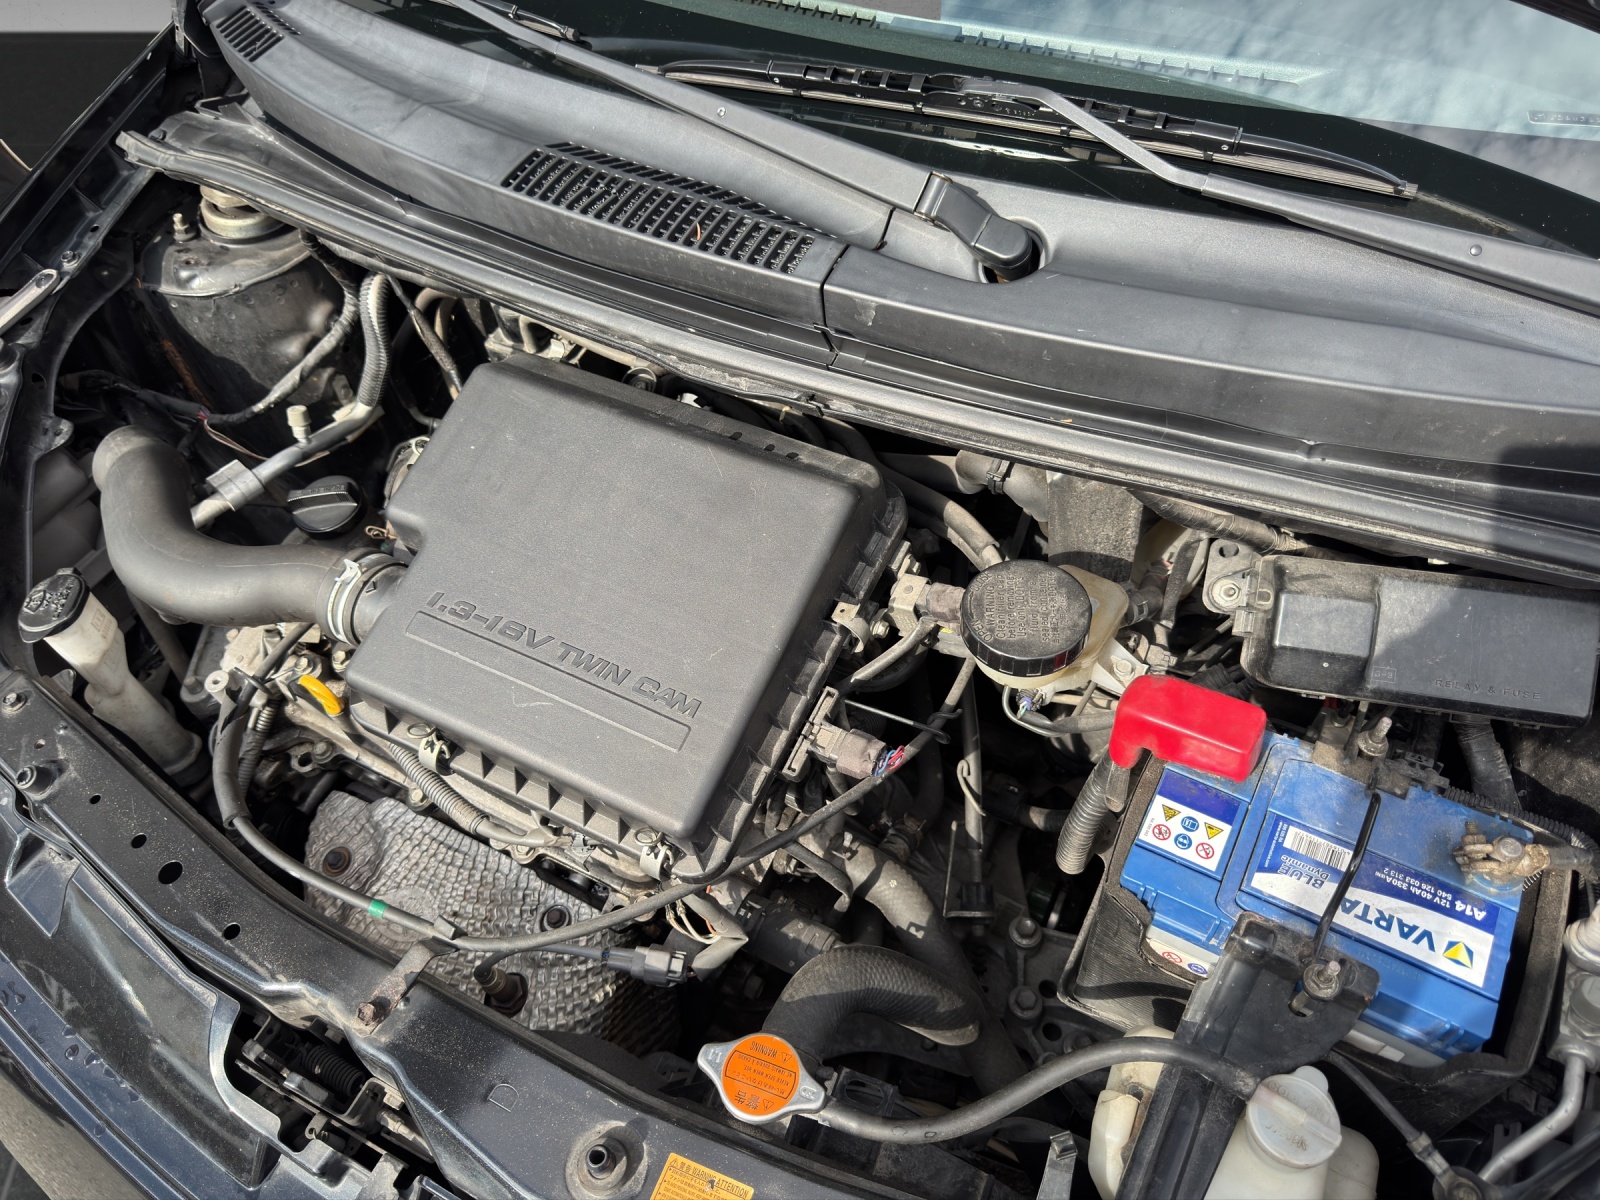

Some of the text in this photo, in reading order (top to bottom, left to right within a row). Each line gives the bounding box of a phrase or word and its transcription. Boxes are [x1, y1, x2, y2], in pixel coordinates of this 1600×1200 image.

[986, 585, 995, 627] WARNING
[1029, 588, 1038, 607] from
[971, 619, 993, 642] OPEN
[996, 613, 1006, 639] Clean
[1007, 612, 1017, 639] before
[1017, 622, 1026, 637] Use
[1041, 616, 1050, 643] sealed
[426, 592, 702, 718] 1.3-16V TWIN CAM
[1435, 679, 1541, 700] RELAY & FUSE
[1277, 862, 1326, 889] BLUE
[1280, 854, 1331, 880] Dynamic
[1390, 870, 1404, 881] 313
[1405, 876, 1420, 888] 033
[1421, 882, 1435, 894] 126
[1410, 886, 1433, 901] 40Ah
[1433, 896, 1451, 908] 12V
[1437, 889, 1452, 901] 540
[1455, 900, 1487, 921] A14
[1340, 897, 1436, 953] VARTA
[750, 1041, 778, 1059] WARNING
[734, 1089, 760, 1110] 警告
[715, 1178, 749, 1198] ATTENTION
